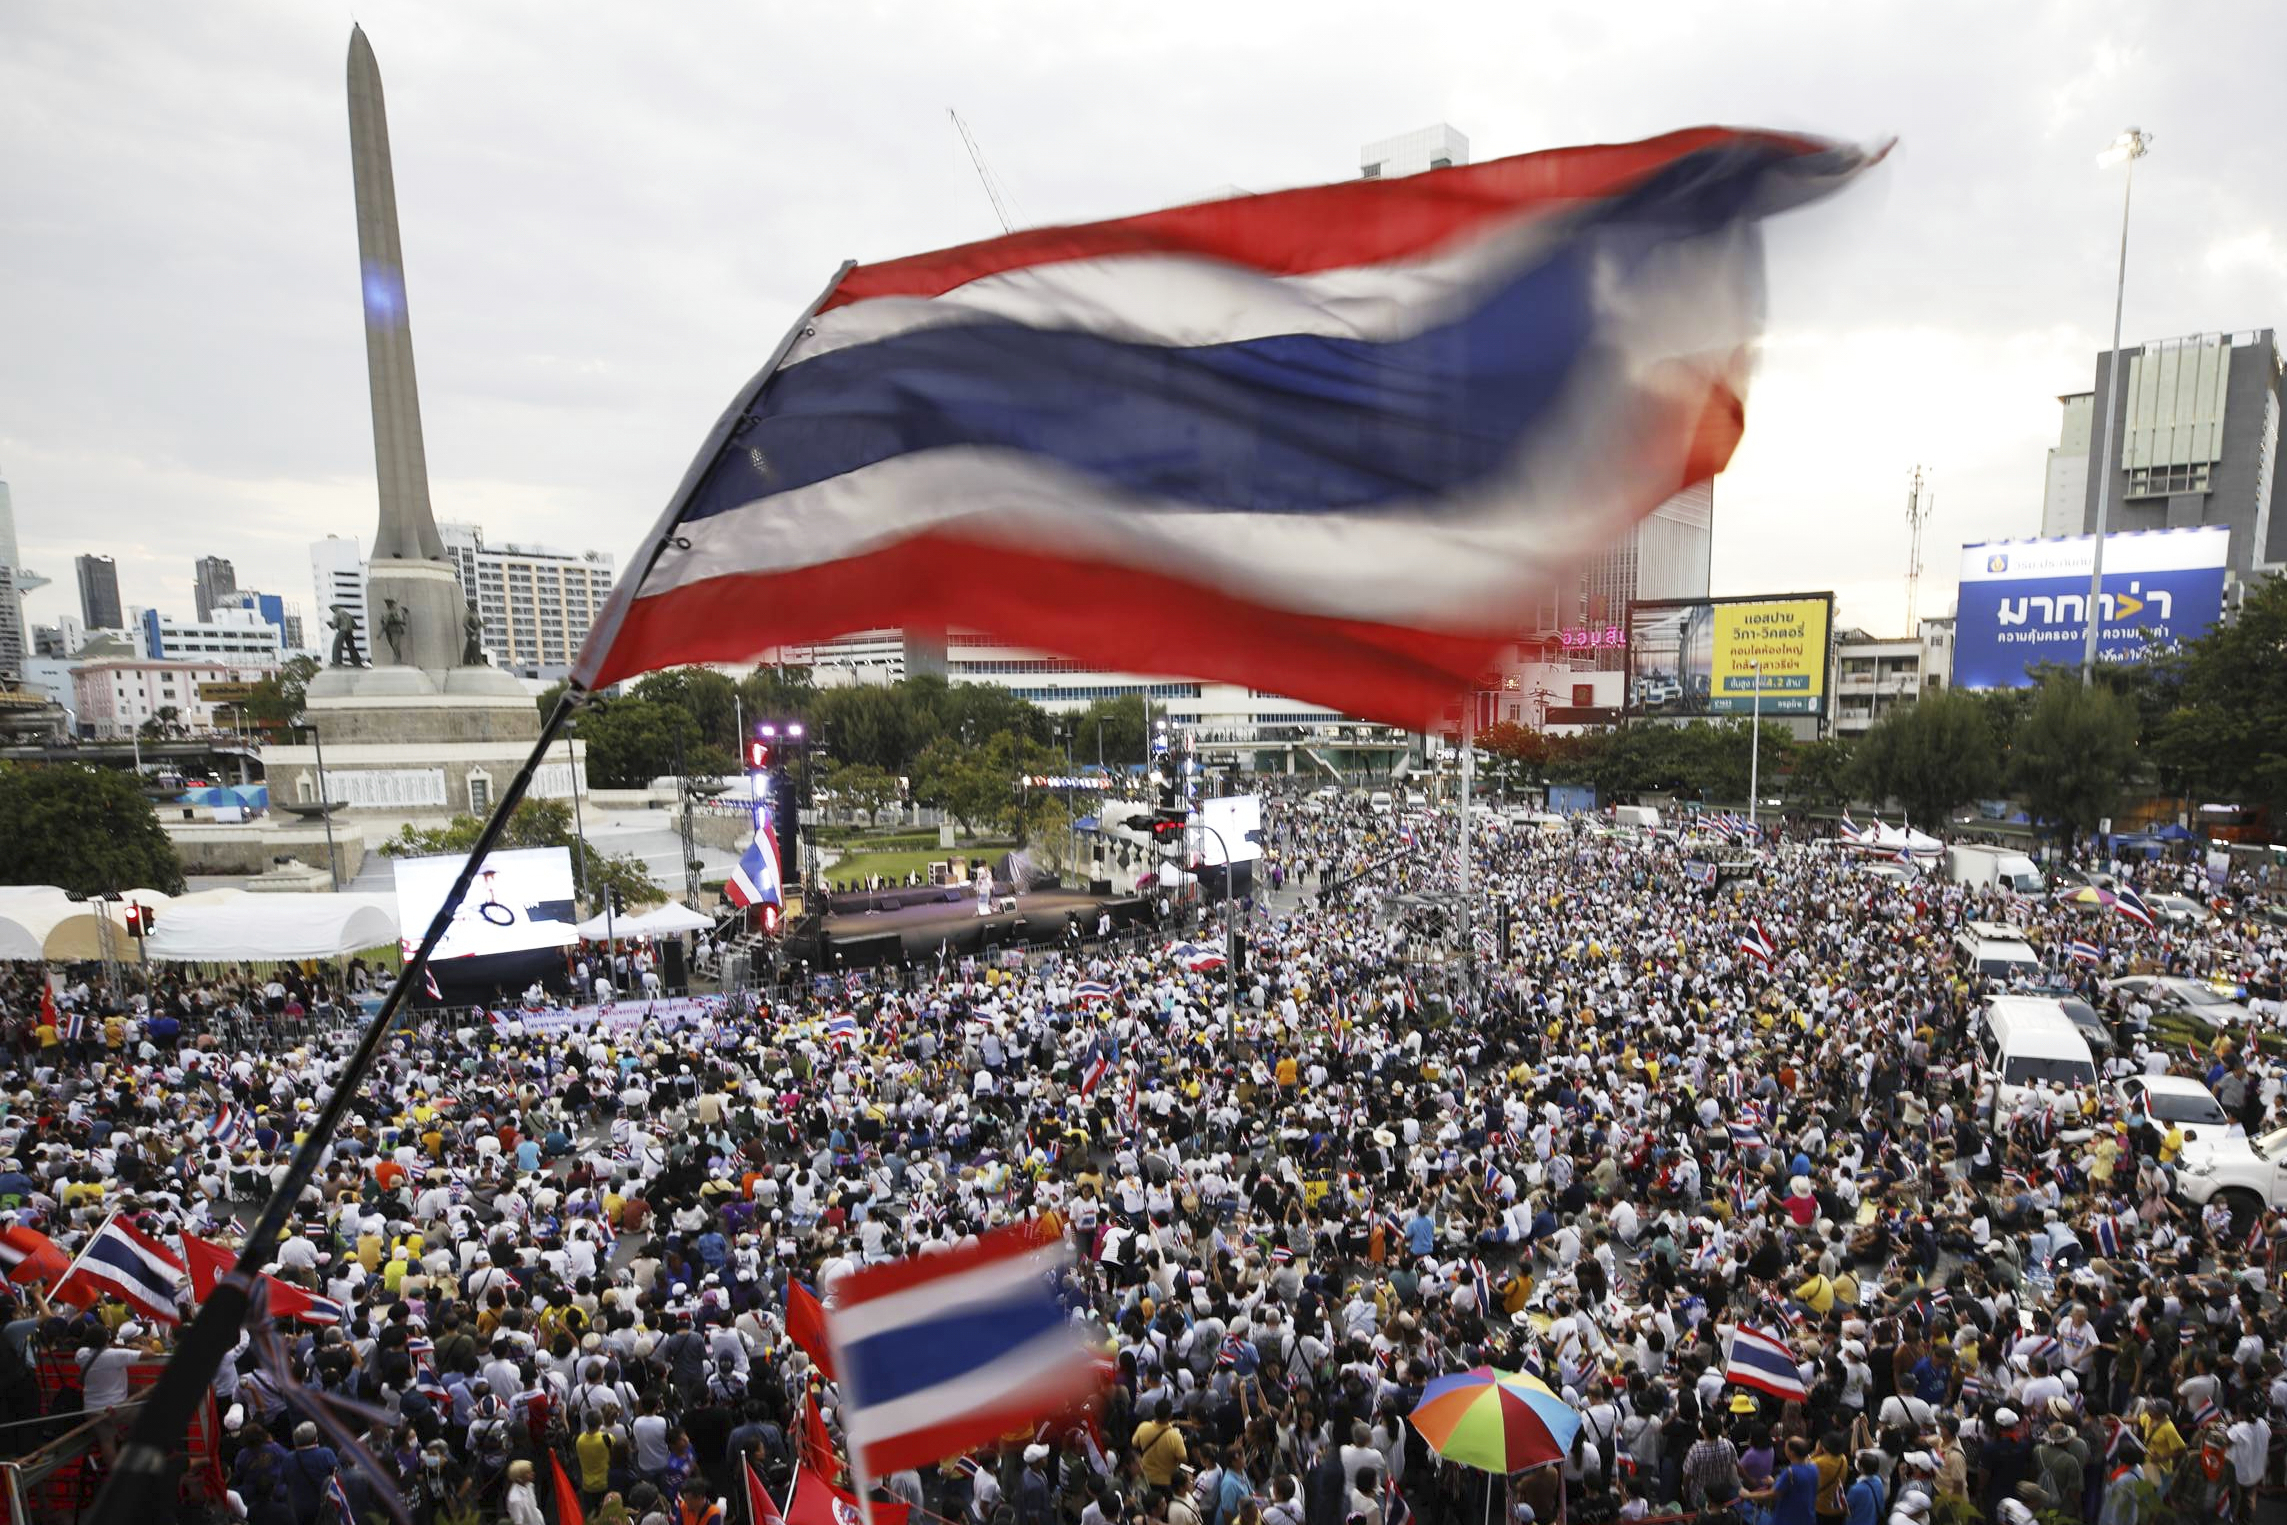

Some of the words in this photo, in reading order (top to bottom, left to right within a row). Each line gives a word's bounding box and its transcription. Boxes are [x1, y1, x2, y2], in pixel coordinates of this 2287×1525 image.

[1998, 628, 2079, 645] ความคุ้มครอง
